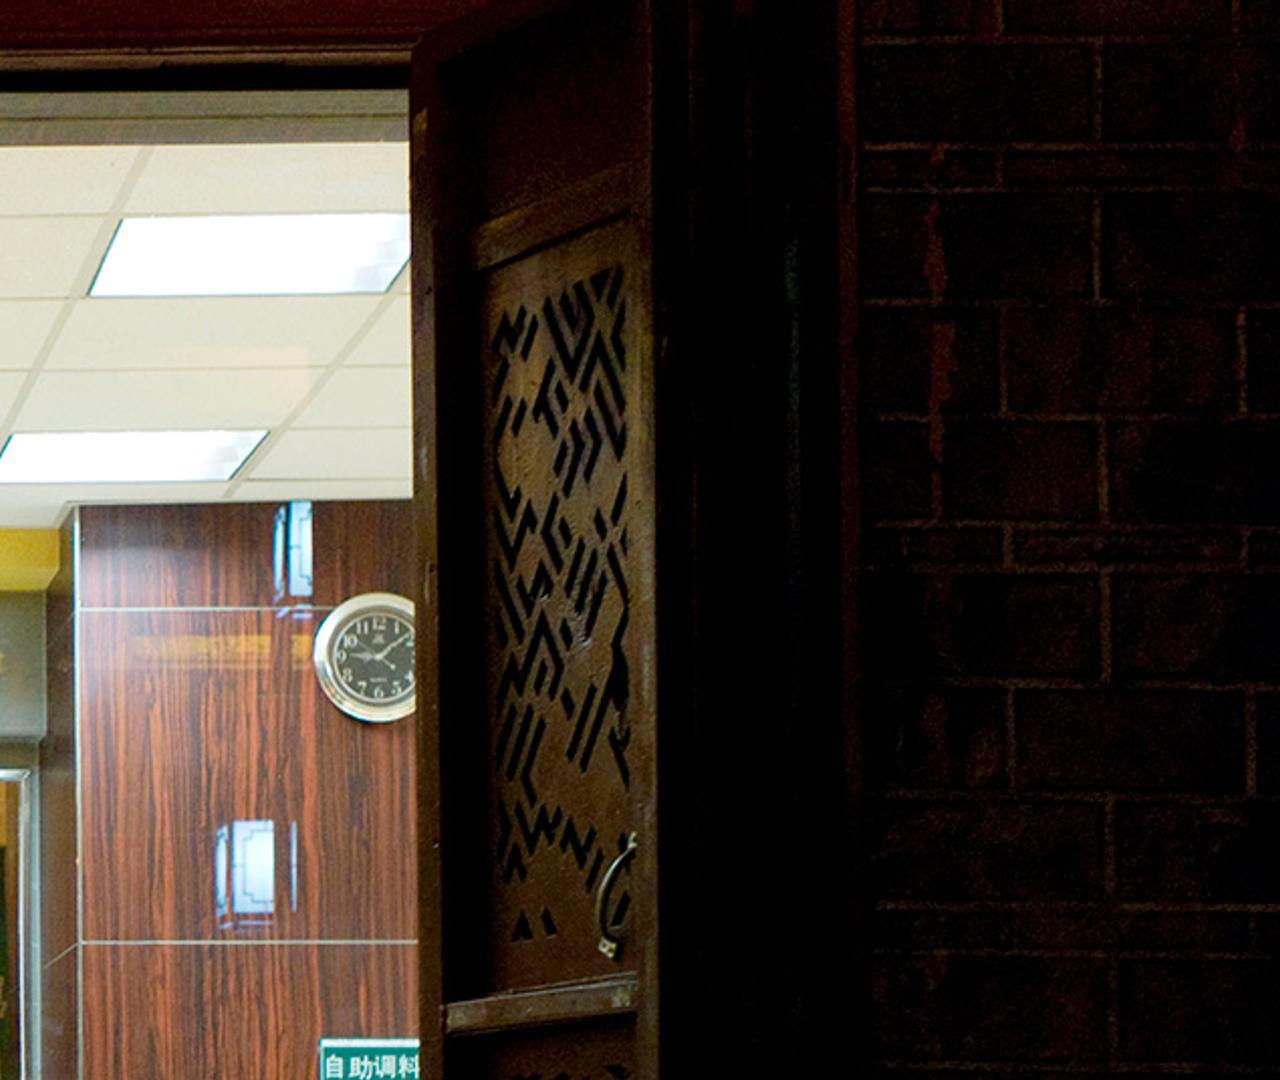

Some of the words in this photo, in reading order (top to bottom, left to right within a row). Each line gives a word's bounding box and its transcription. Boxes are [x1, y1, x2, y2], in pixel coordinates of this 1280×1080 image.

[356, 620, 368, 634] 11
[372, 617, 387, 630] 12
[343, 634, 358, 647] 10
[342, 668, 352, 682] 8
[358, 682, 367, 695] 7
[374, 686, 384, 699] 6
[391, 682, 402, 695] 5
[326, 1053, 420, 1080] 自助调料
